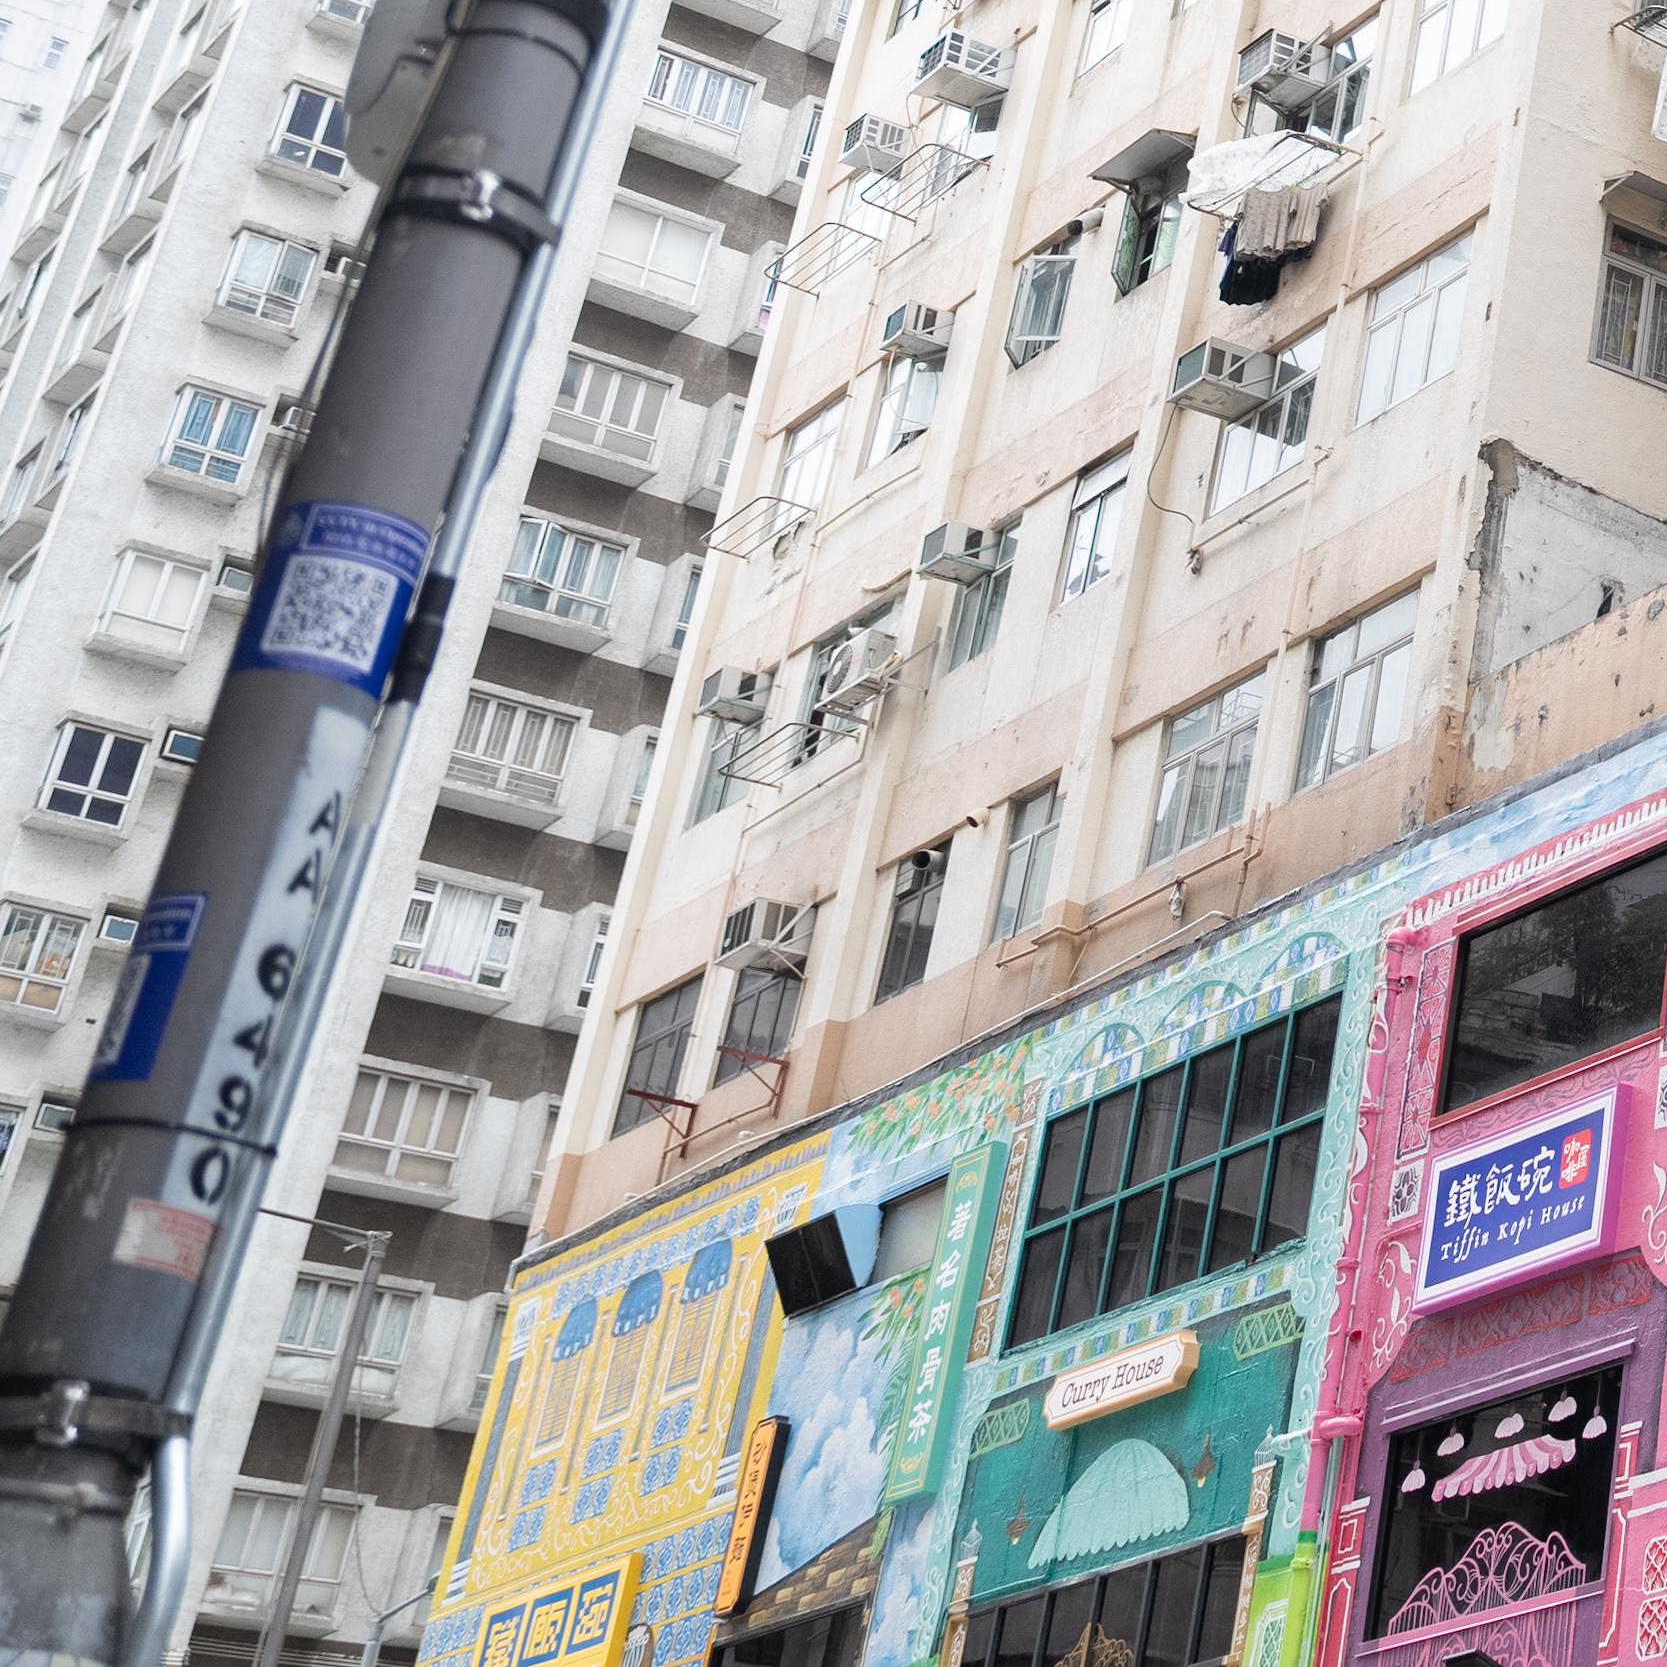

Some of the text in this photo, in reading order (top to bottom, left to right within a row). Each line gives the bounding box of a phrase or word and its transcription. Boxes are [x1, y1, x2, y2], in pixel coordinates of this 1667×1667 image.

[1444, 1146, 1556, 1229] 鐵飯碗
[1440, 1195, 1586, 1264] Tiffin Kopi House
[907, 1199, 974, 1444] 著名肉骨茶
[1062, 1355, 1164, 1408] Curry House
